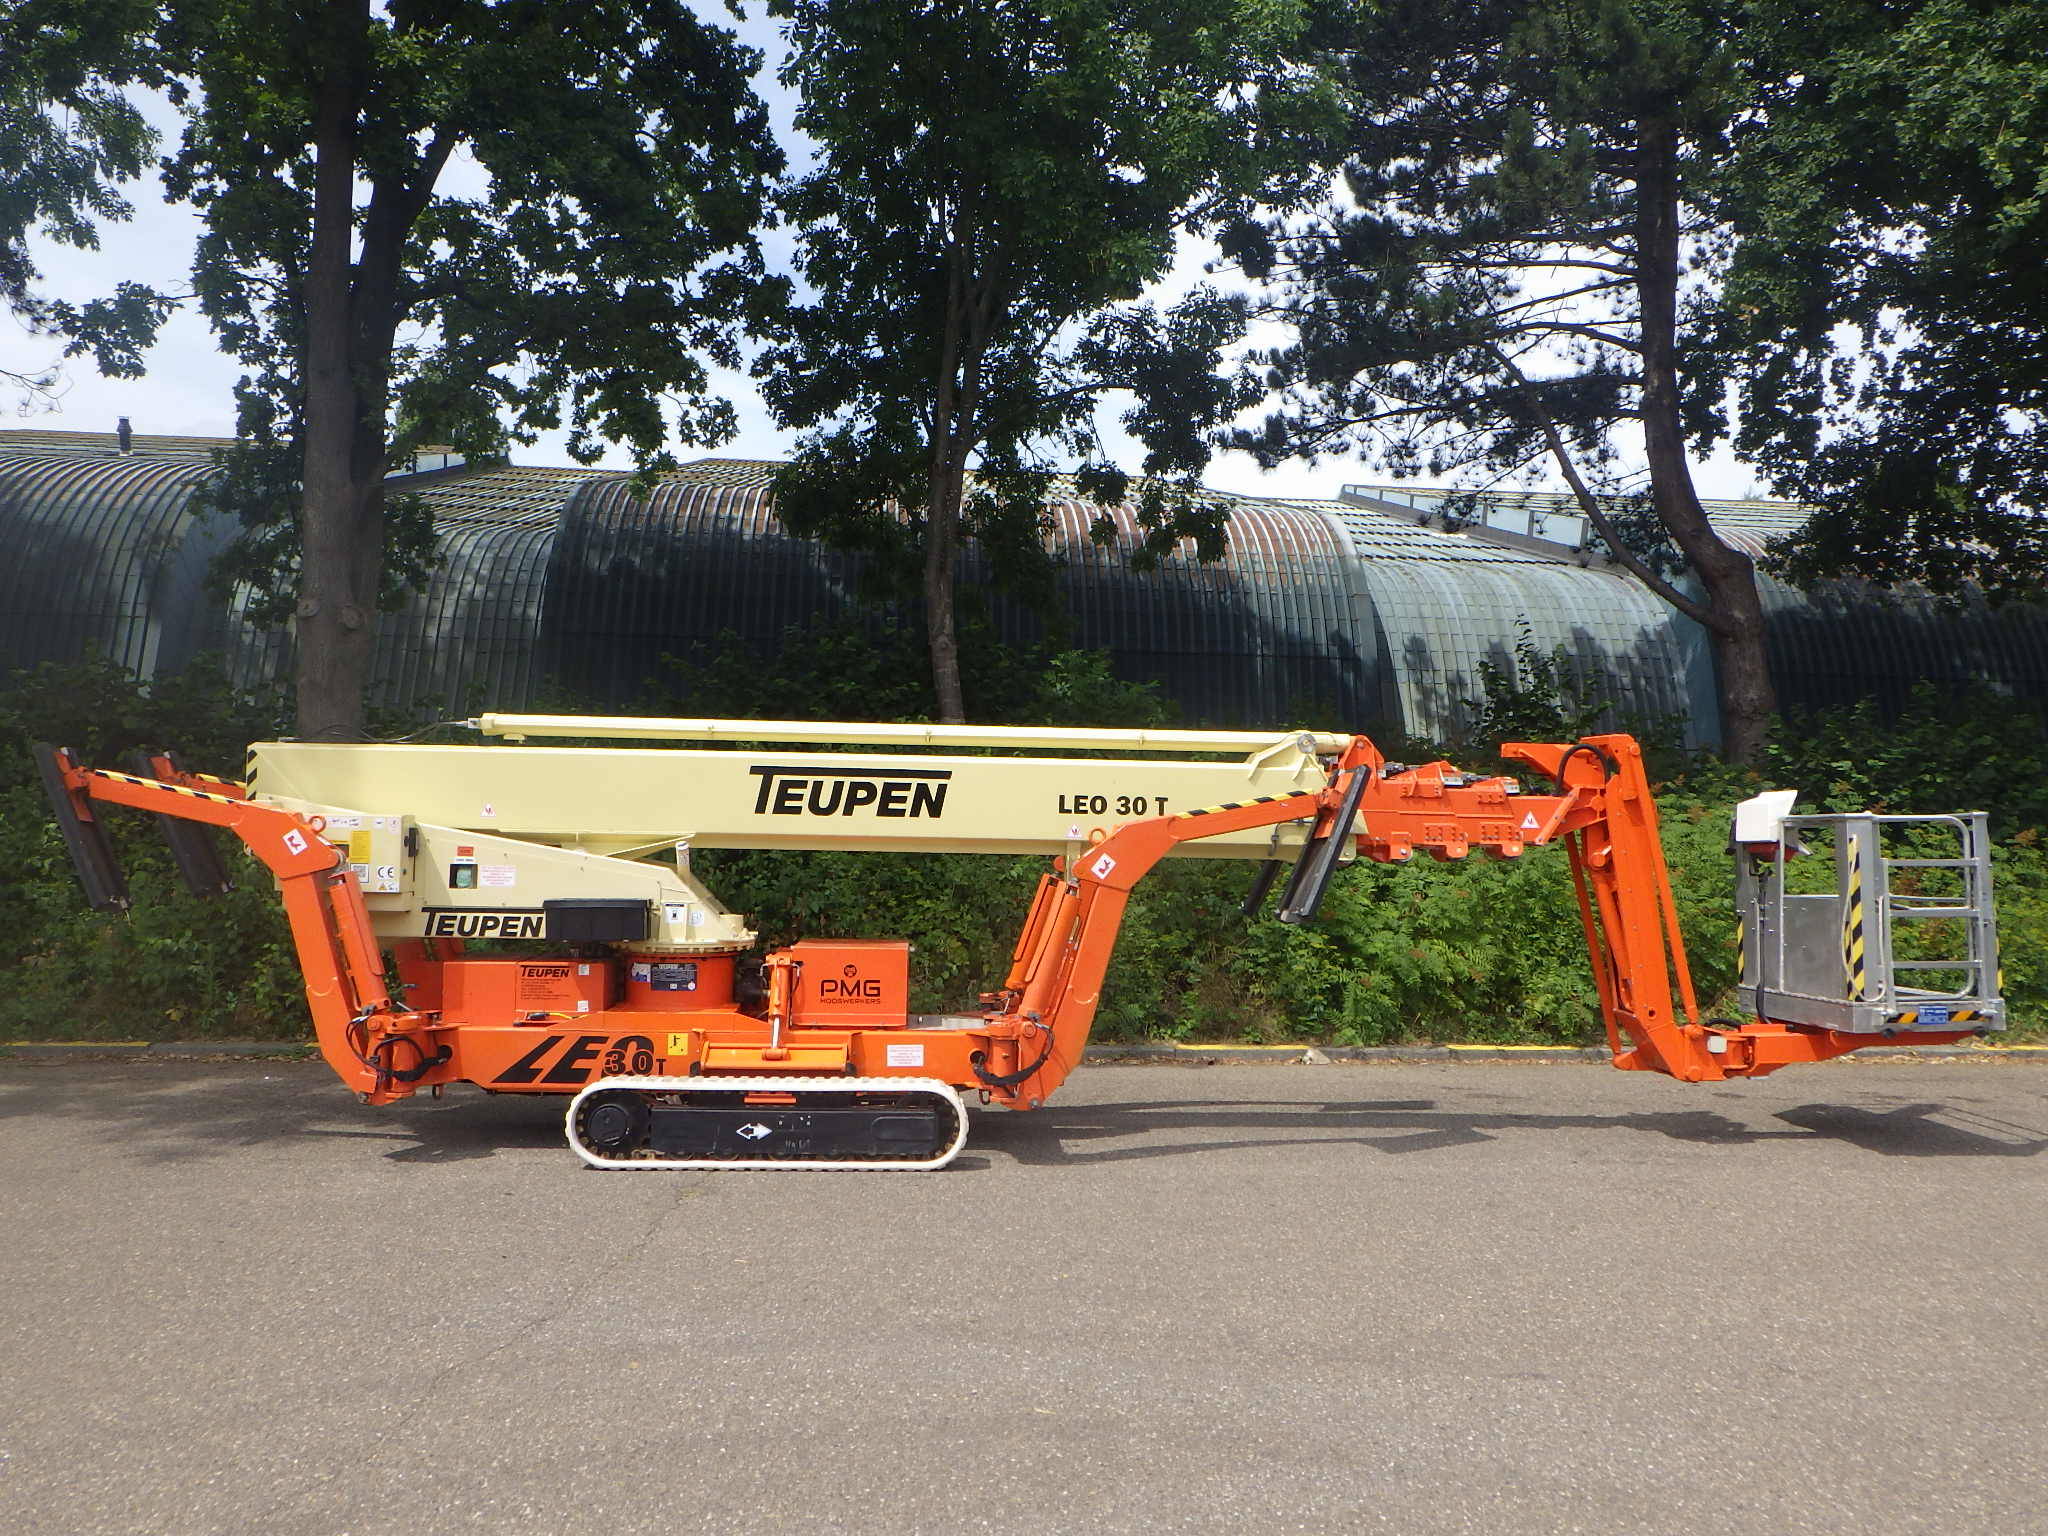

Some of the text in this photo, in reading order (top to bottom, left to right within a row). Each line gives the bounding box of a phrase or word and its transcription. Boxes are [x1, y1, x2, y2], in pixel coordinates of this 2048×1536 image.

[749, 765, 953, 818] TEUPEN
[1058, 794, 1169, 816] LEO 30 T
[377, 866, 395, 879] CE
[421, 906, 545, 938] TEUPEN
[520, 964, 570, 978] TEUPEN
[820, 979, 881, 997] PMG
